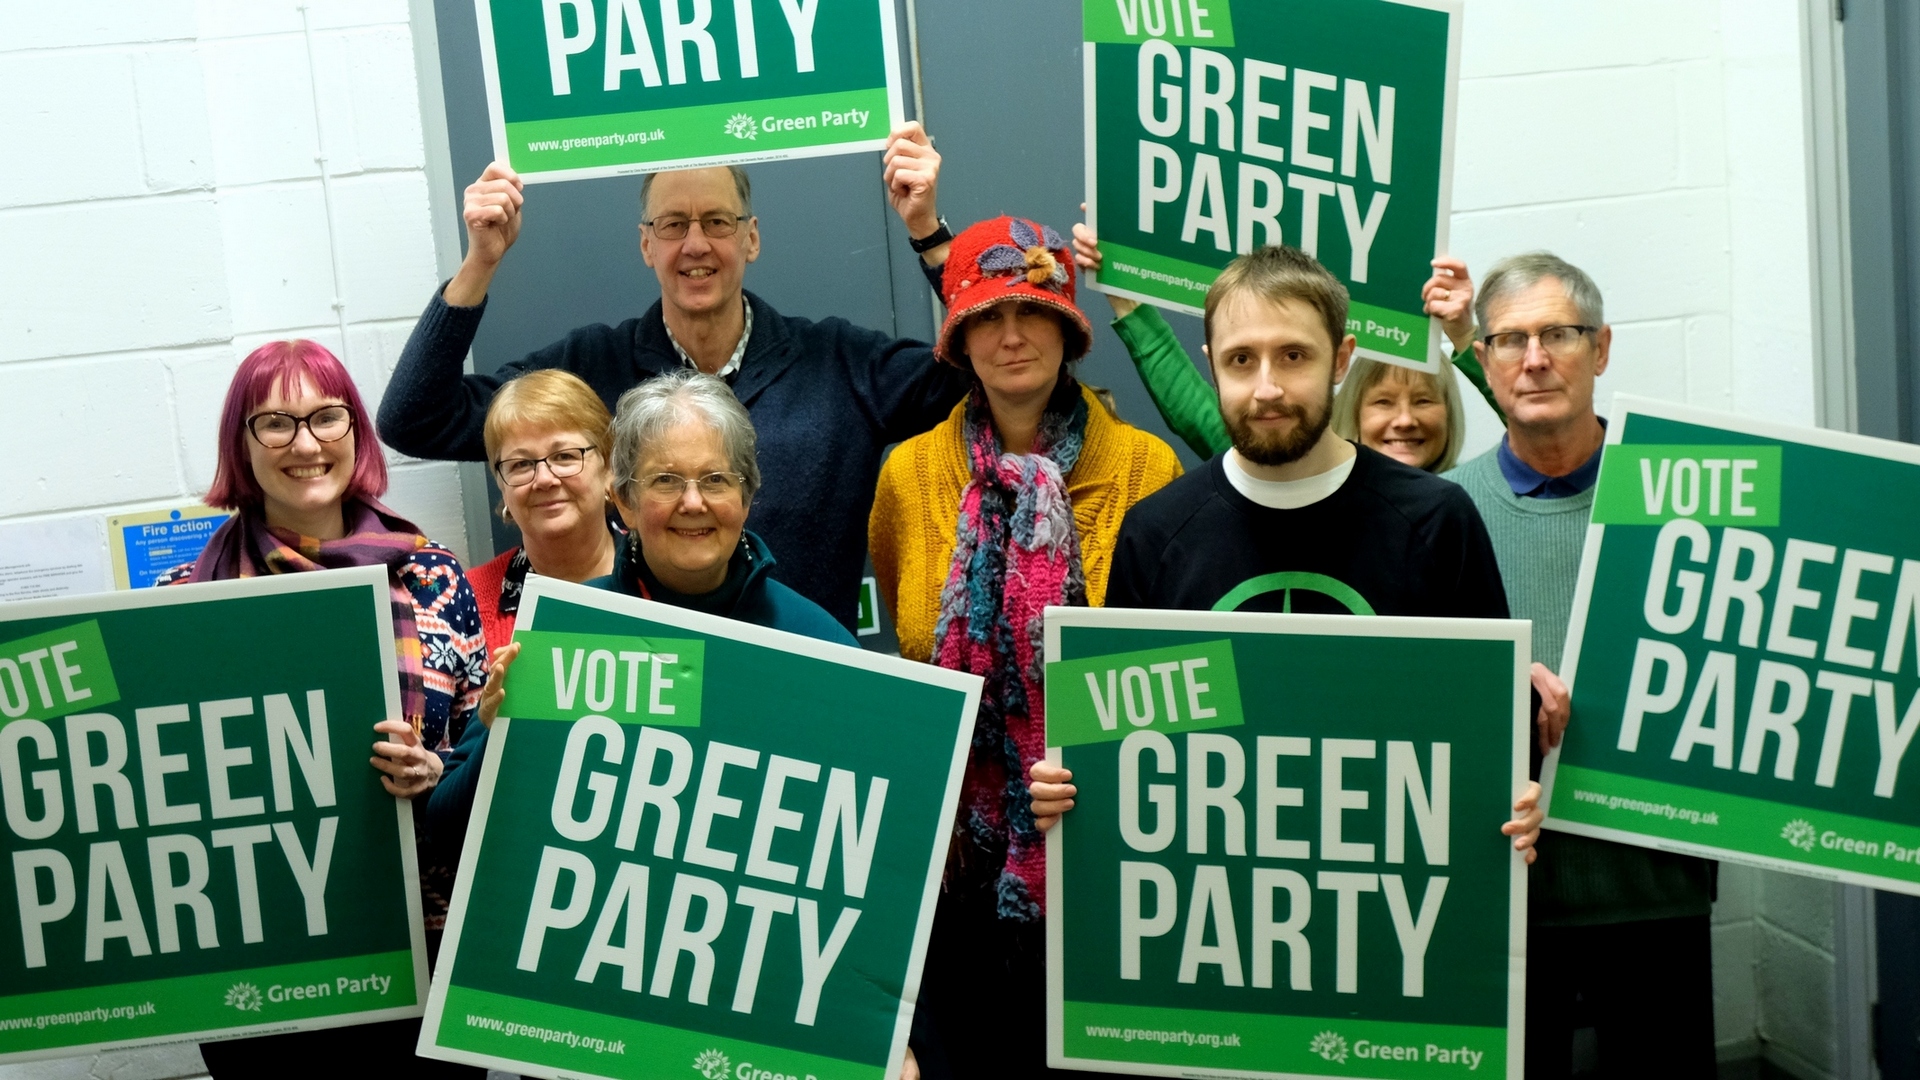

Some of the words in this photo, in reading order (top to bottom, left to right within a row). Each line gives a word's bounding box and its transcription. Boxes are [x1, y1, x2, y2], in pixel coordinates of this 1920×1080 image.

[542, 0, 818, 95] PARTY
[1116, 0, 1214, 37] VOTE
[528, 129, 665, 151] www.greenparty.org.uk
[762, 116, 816, 132] Green
[822, 109, 869, 126] Party
[1138, 37, 1395, 184] GREEN
[1139, 140, 1390, 283] PARTY
[1366, 320, 1410, 346] Party
[1640, 458, 1757, 516] VOTE
[143, 525, 168, 537] Fire
[173, 521, 212, 533] action
[0, 641, 92, 717] OTE
[552, 648, 678, 714] VOTE
[1085, 658, 1217, 730] VOTE
[1618, 638, 1920, 798] PARTY
[0, 689, 336, 839] GREEN
[1119, 729, 1450, 865] GREEN
[551, 714, 889, 898] GREEN
[1575, 791, 1718, 825] www.greenparty.org.uk
[1820, 831, 1879, 856] Green
[12, 816, 339, 968] PARTY
[517, 846, 862, 1026] PARTY
[1121, 861, 1449, 997] PARTY
[268, 983, 330, 1002] Green
[337, 974, 391, 994] Party
[467, 1015, 625, 1054] www.greenparty.org.uk
[1086, 1026, 1240, 1048] www.greenparty.org.uk
[1354, 1040, 1418, 1061] Green
[1425, 1044, 1483, 1070] Party
